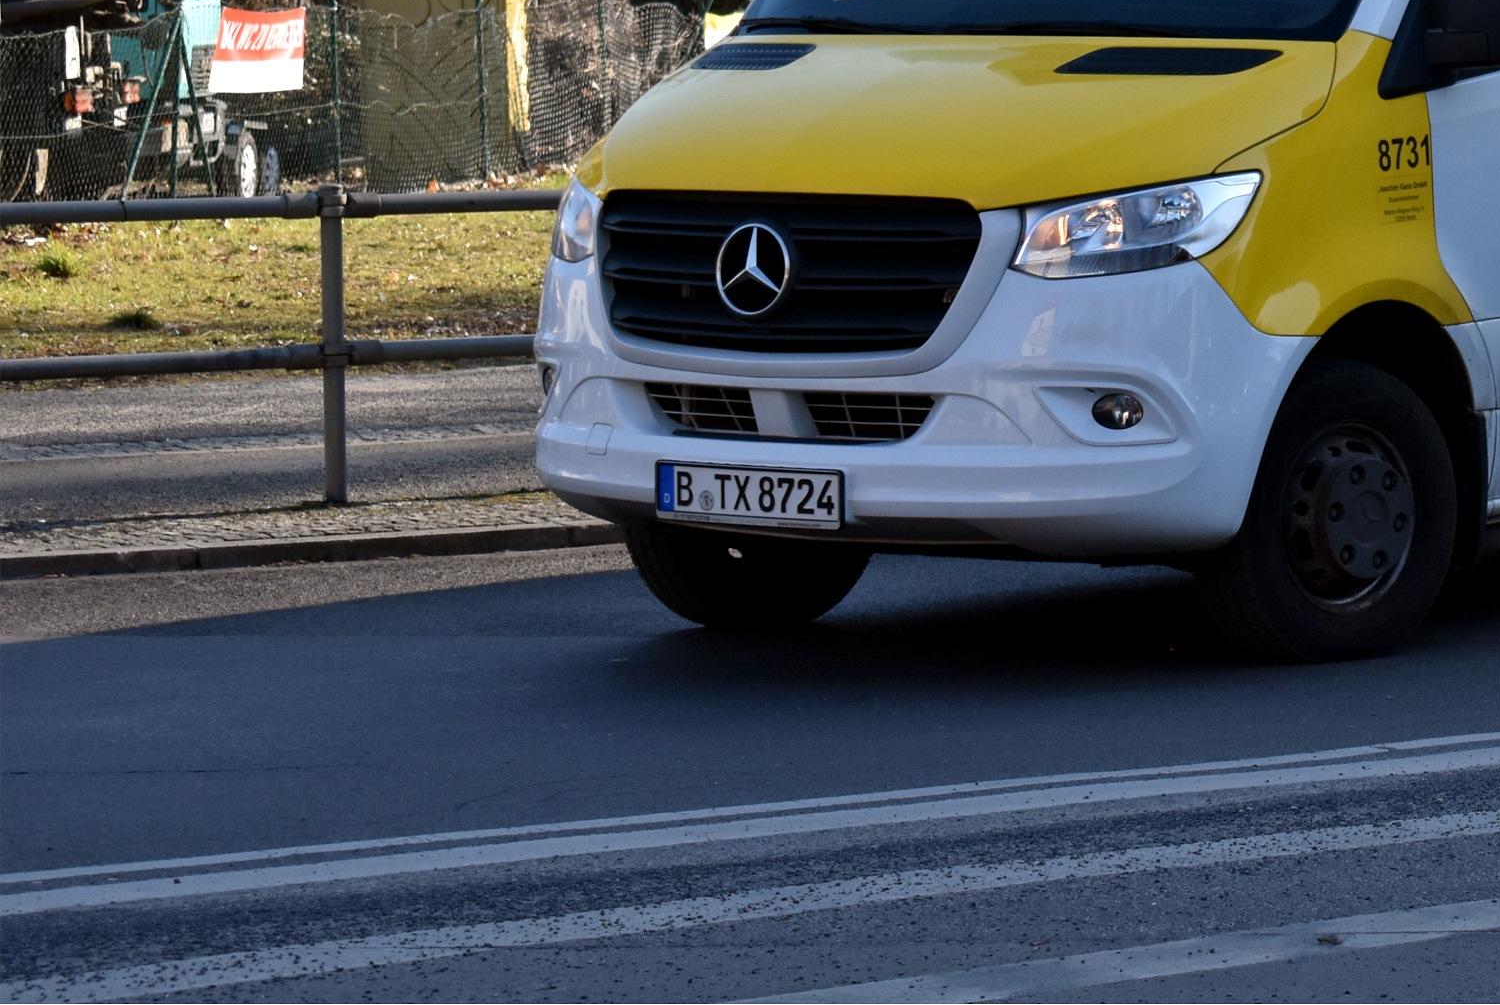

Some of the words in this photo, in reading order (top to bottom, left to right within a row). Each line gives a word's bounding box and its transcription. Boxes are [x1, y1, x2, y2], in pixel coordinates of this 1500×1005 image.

[1377, 134, 1431, 172] 8731
[676, 470, 694, 507] B
[714, 473, 752, 512] TX
[758, 476, 835, 516] 8724
